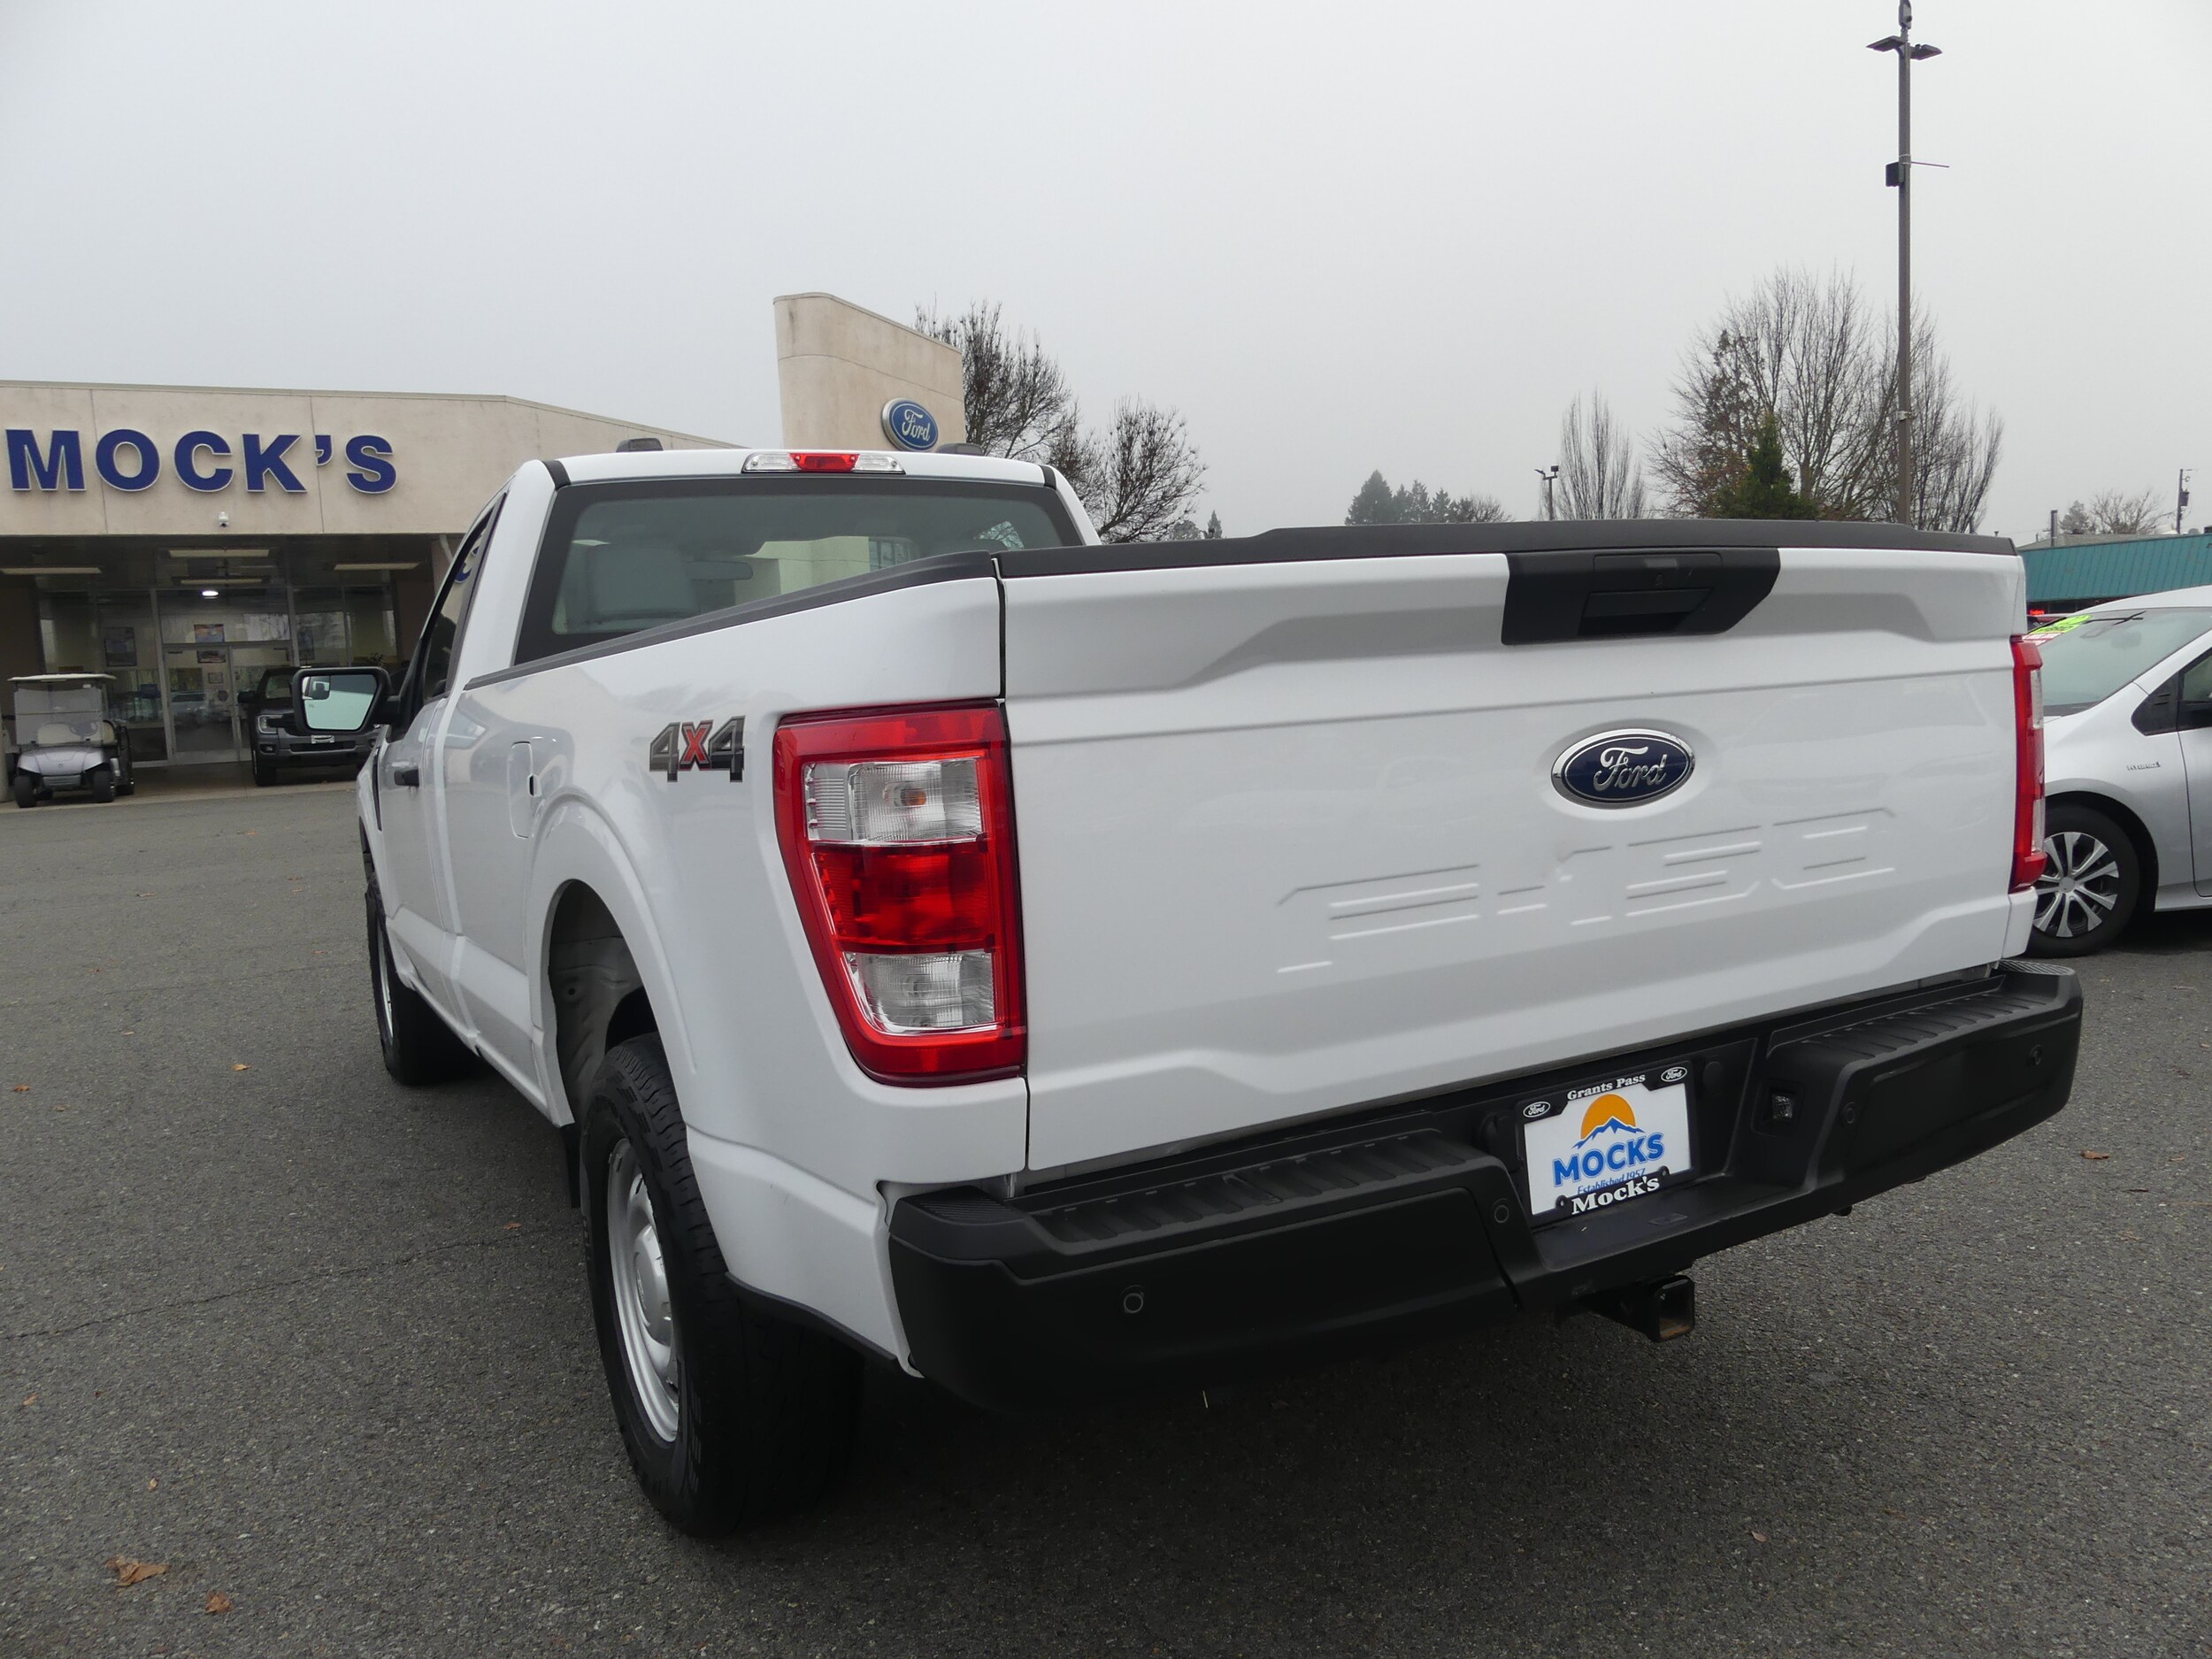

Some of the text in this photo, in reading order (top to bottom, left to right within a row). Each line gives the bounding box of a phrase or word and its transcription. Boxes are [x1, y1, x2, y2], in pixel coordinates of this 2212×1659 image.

[902, 409, 931, 442] Ford
[4, 428, 398, 494] MOCK'S
[1594, 746, 1668, 791] Ford
[1567, 1074, 1646, 1101] Grants Pass
[1553, 1133, 1664, 1187] MOCKS
[1571, 1176, 1660, 1215] Mock's
